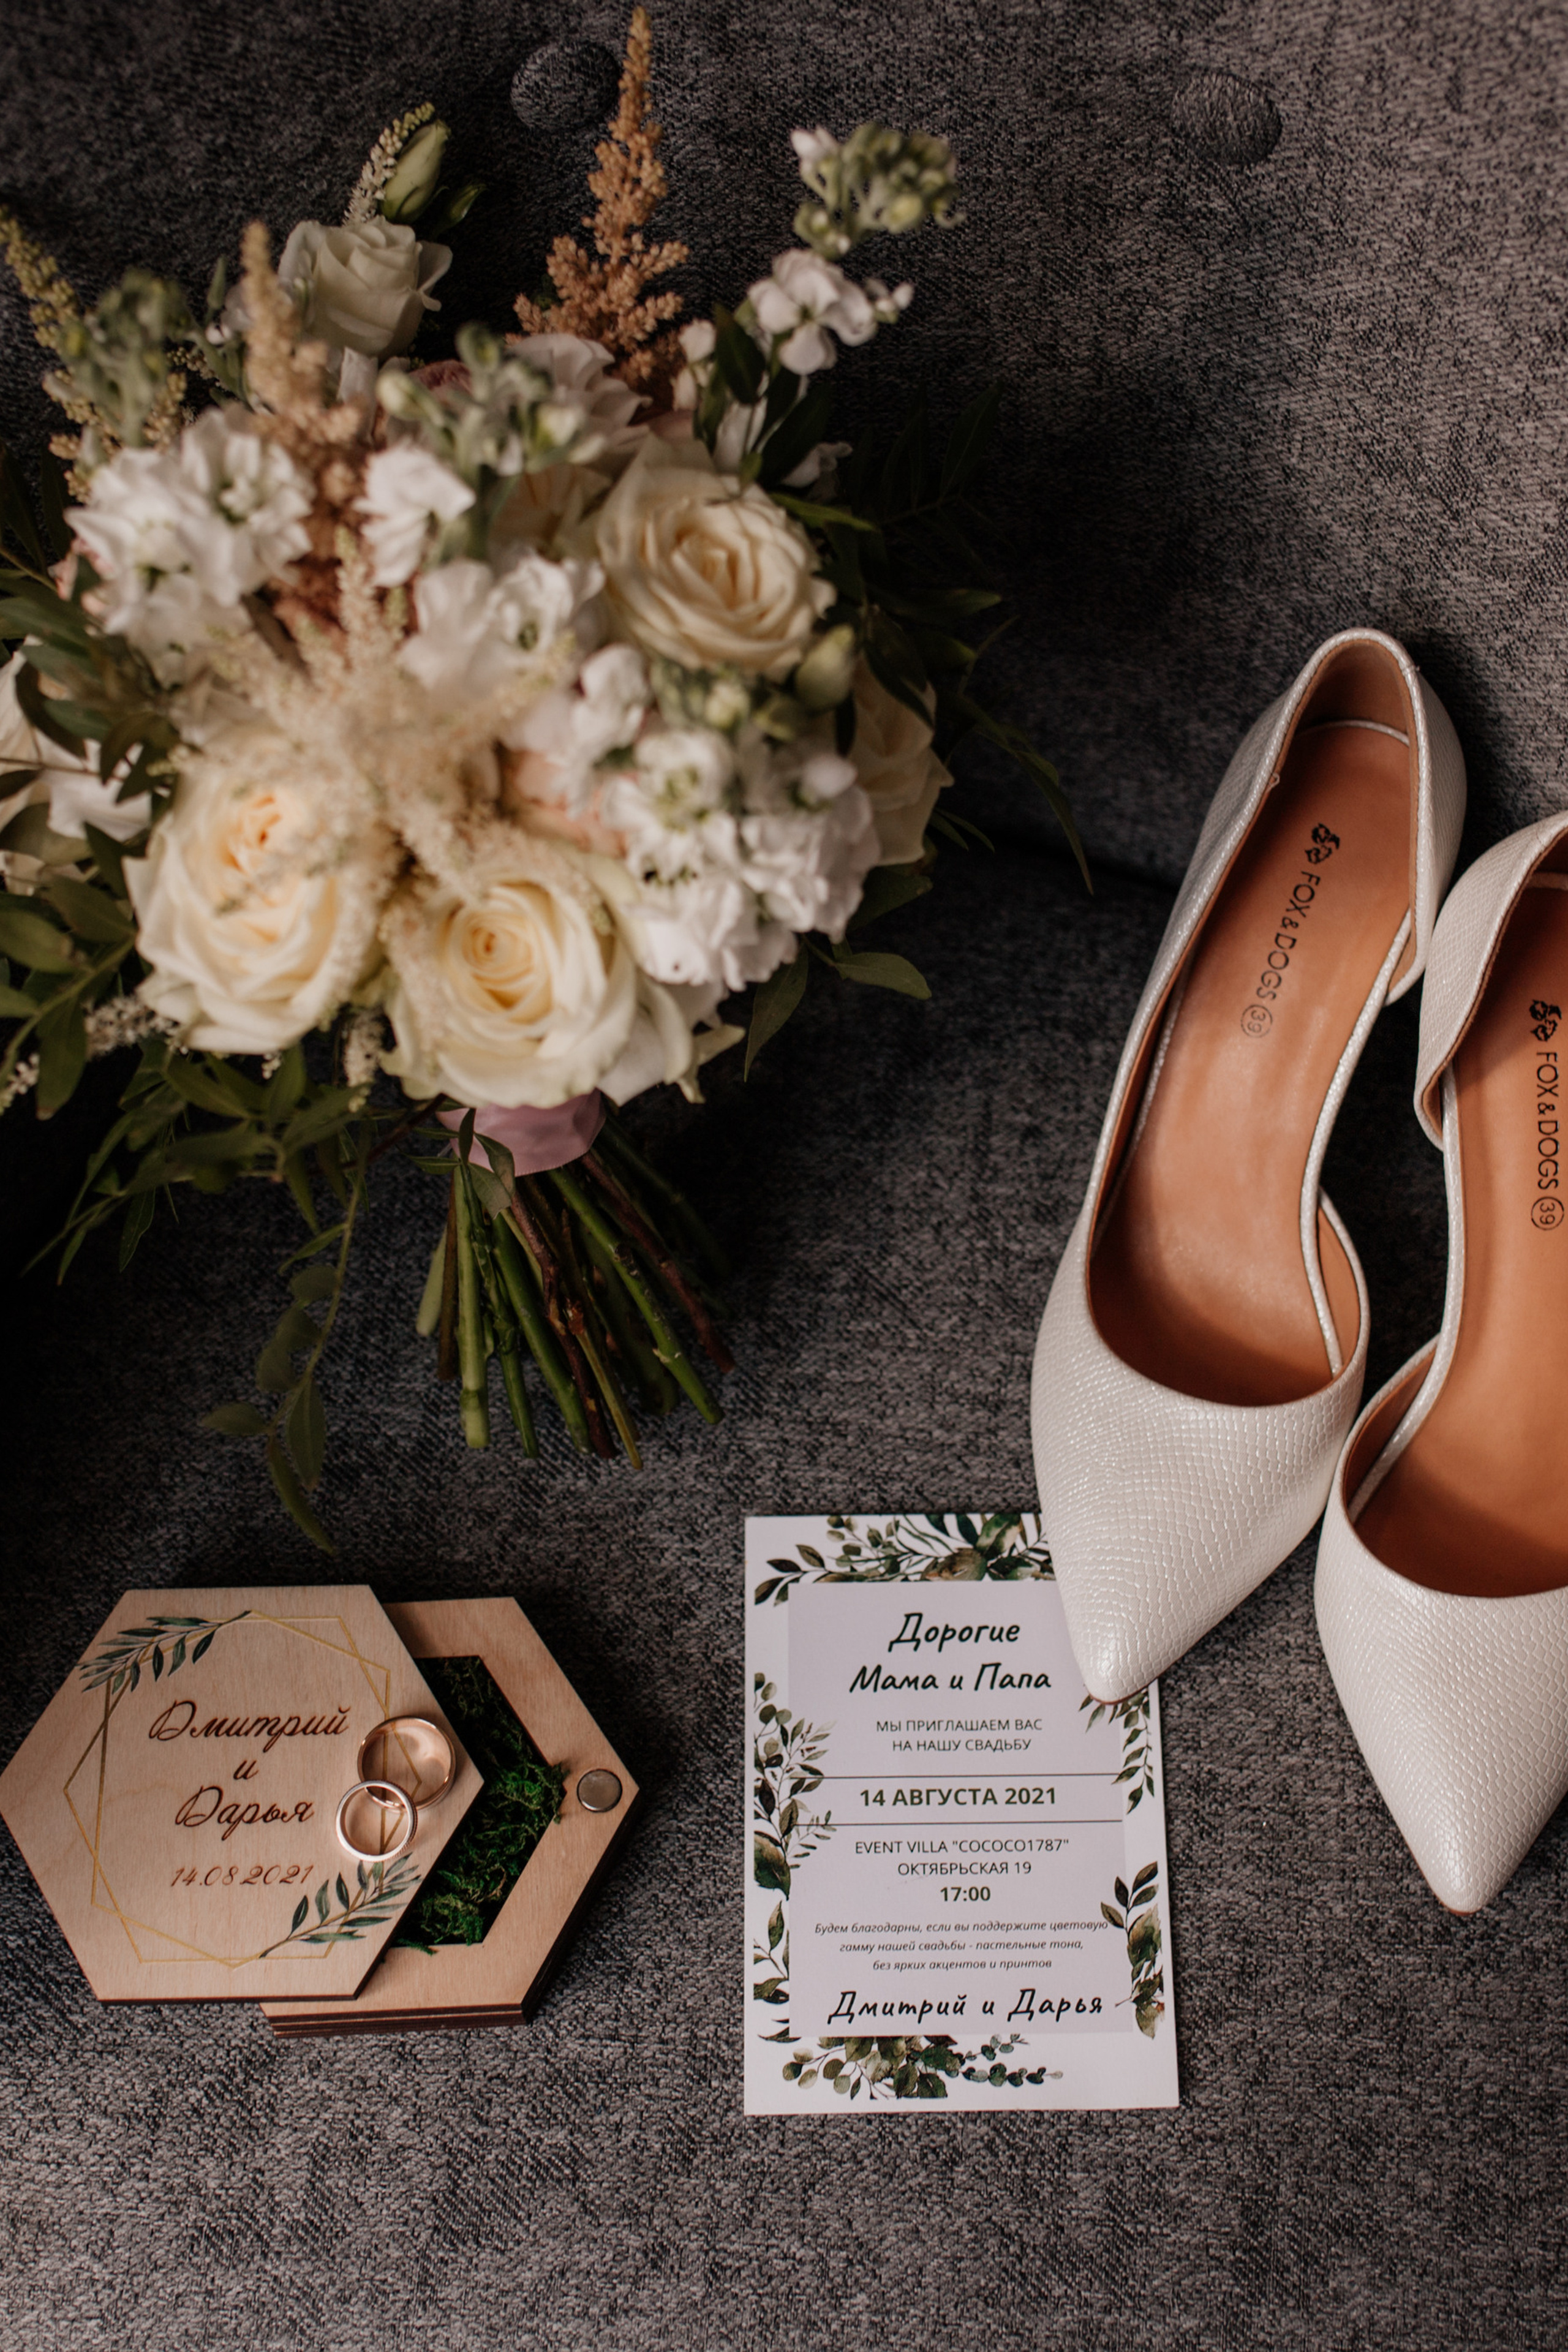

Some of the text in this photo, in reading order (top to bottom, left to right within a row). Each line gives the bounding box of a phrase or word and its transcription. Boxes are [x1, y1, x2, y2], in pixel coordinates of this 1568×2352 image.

[1247, 1009, 1266, 1033] 39
[1540, 1202, 1555, 1225] 39
[888, 1611, 1020, 1653] Дорогие
[849, 1662, 1052, 1694] Мама и Папа
[149, 1700, 352, 1753] Дмитрий
[876, 1718, 1042, 1732] МЫ ПРИГЛАШАЕМ ВАС
[892, 1738, 1031, 1753] НА НАШУ СВАДЬБУ
[233, 1760, 258, 1780] и
[860, 1787, 1055, 1807] 14 АВГУСТА 2021
[175, 1785, 314, 1841] Дарья
[855, 1841, 903, 1855] EVENT
[907, 1840, 949, 1853] VILLA
[897, 1861, 1032, 1876] ОКТЯБРЬСКАЯ 19
[940, 1886, 991, 1902] 17:00
[815, 1920, 1108, 1936] Будем благодарны, если вы поддержите цветовую
[839, 1943, 875, 1954] гамму
[877, 1940, 916, 1951] нашей
[918, 1940, 966, 1951] свадьбы
[975, 1941, 1047, 1950] пастельные
[1049, 1940, 1084, 1950] тона,
[872, 1960, 1052, 1973] без ярких акцентов и принтов
[827, 1988, 1102, 2025] Дмитрий и Дарья
